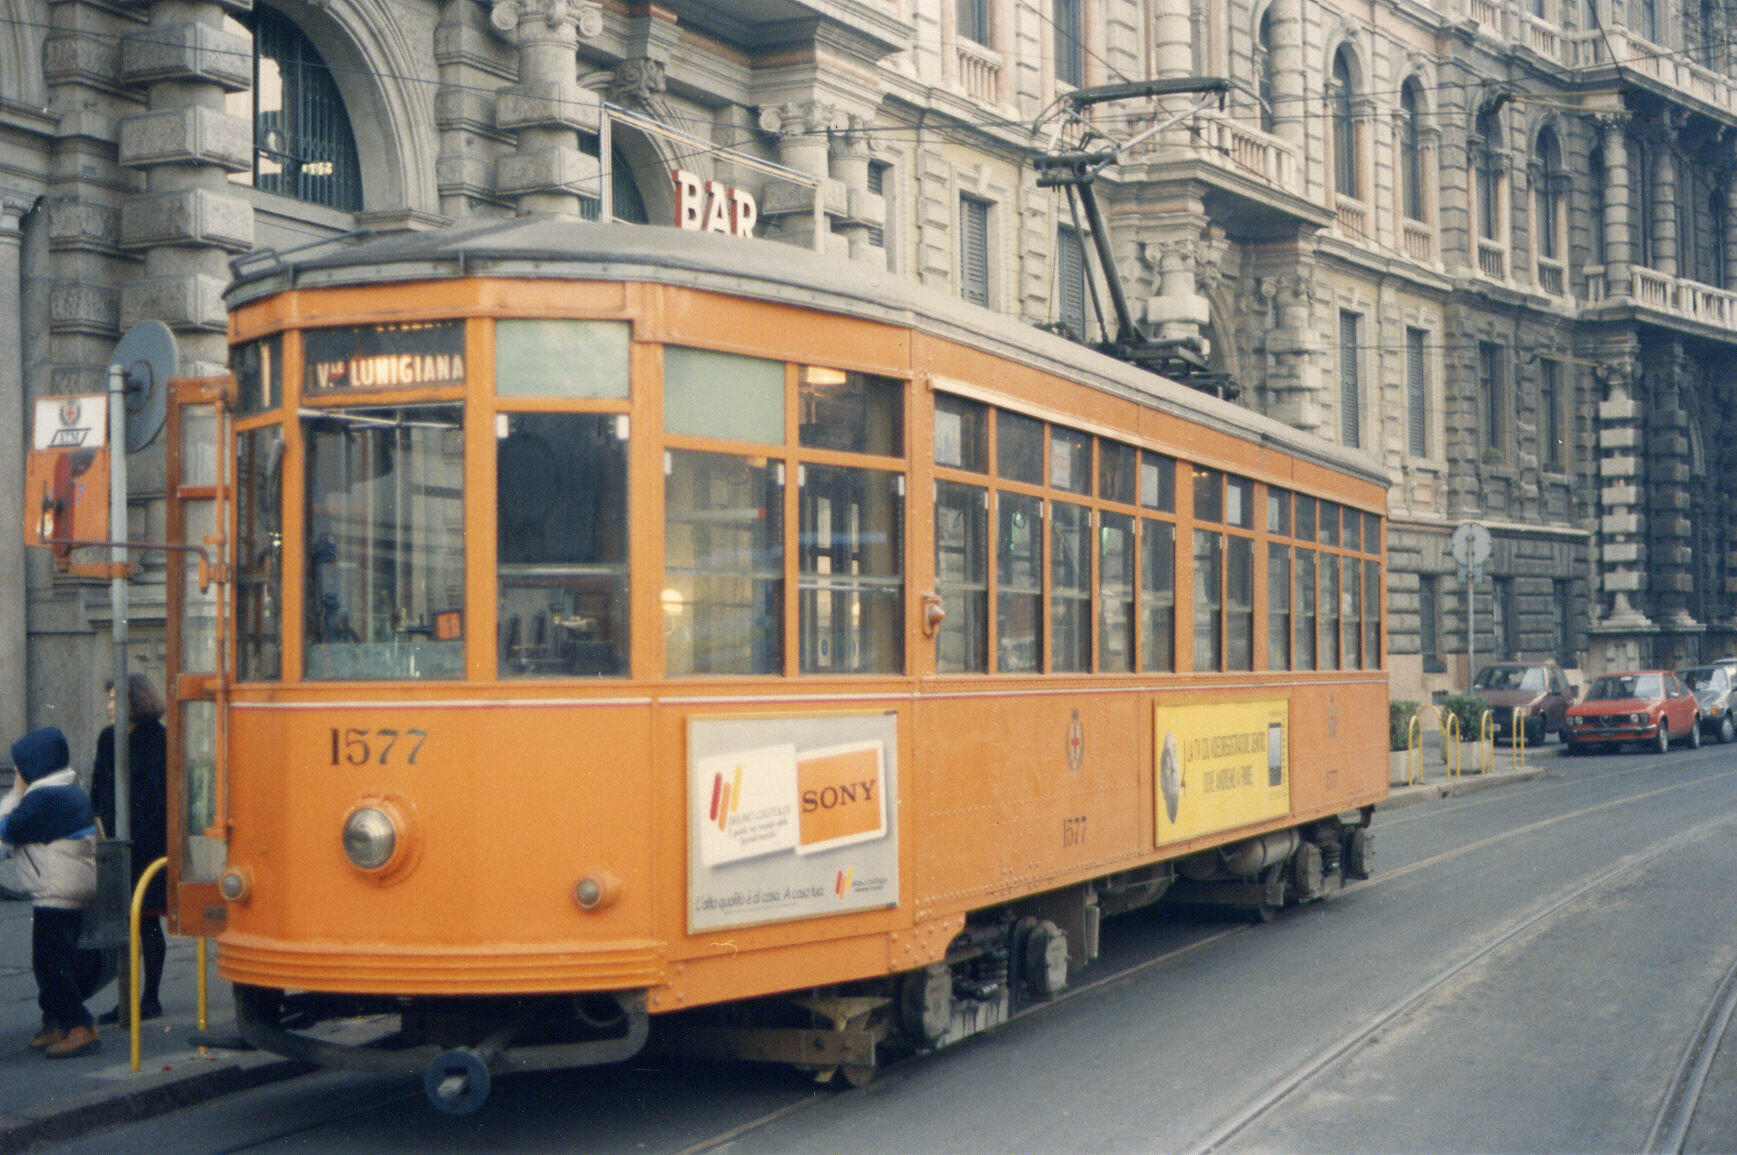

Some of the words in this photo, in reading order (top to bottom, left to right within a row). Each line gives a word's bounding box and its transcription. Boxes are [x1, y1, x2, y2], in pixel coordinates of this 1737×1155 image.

[673, 169, 757, 239] BAR
[351, 354, 465, 387] LUNIGIANA
[330, 728, 429, 766] 1577
[802, 779, 877, 814] SONY
[1063, 815, 1087, 848] 1577
